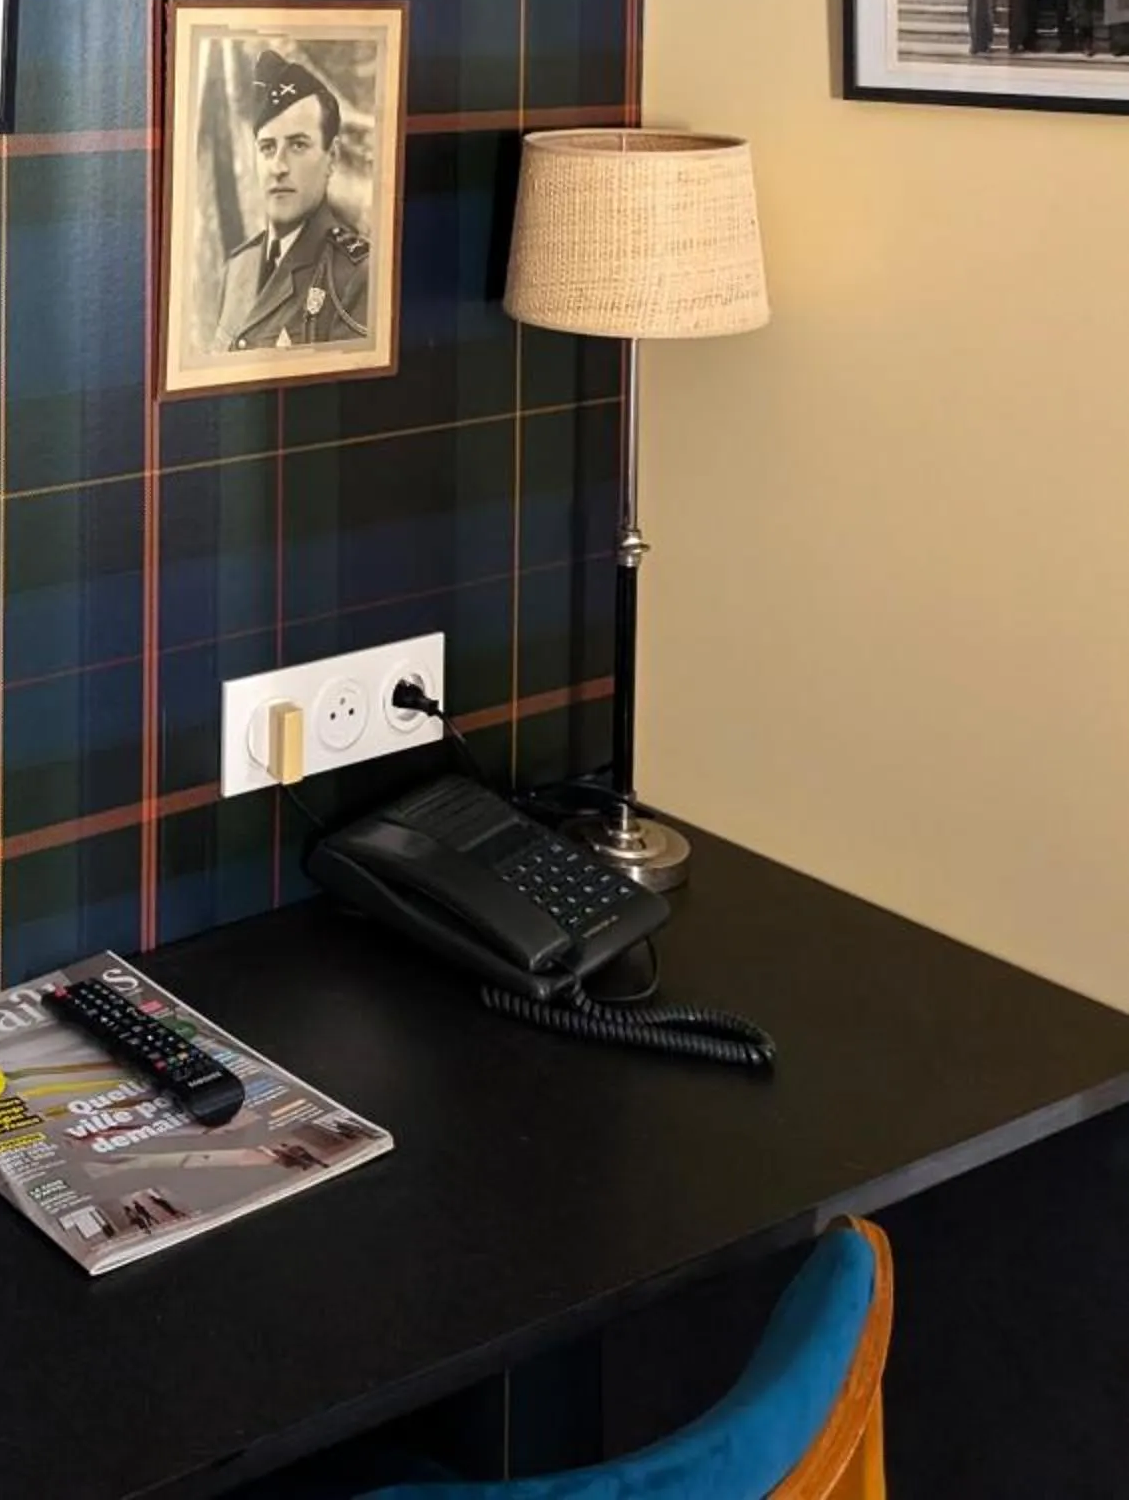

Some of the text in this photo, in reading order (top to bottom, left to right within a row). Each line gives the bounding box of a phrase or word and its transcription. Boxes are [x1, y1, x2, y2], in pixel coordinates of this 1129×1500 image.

[68, 1079, 148, 1115] Quell
[65, 1096, 171, 1138] ville po
